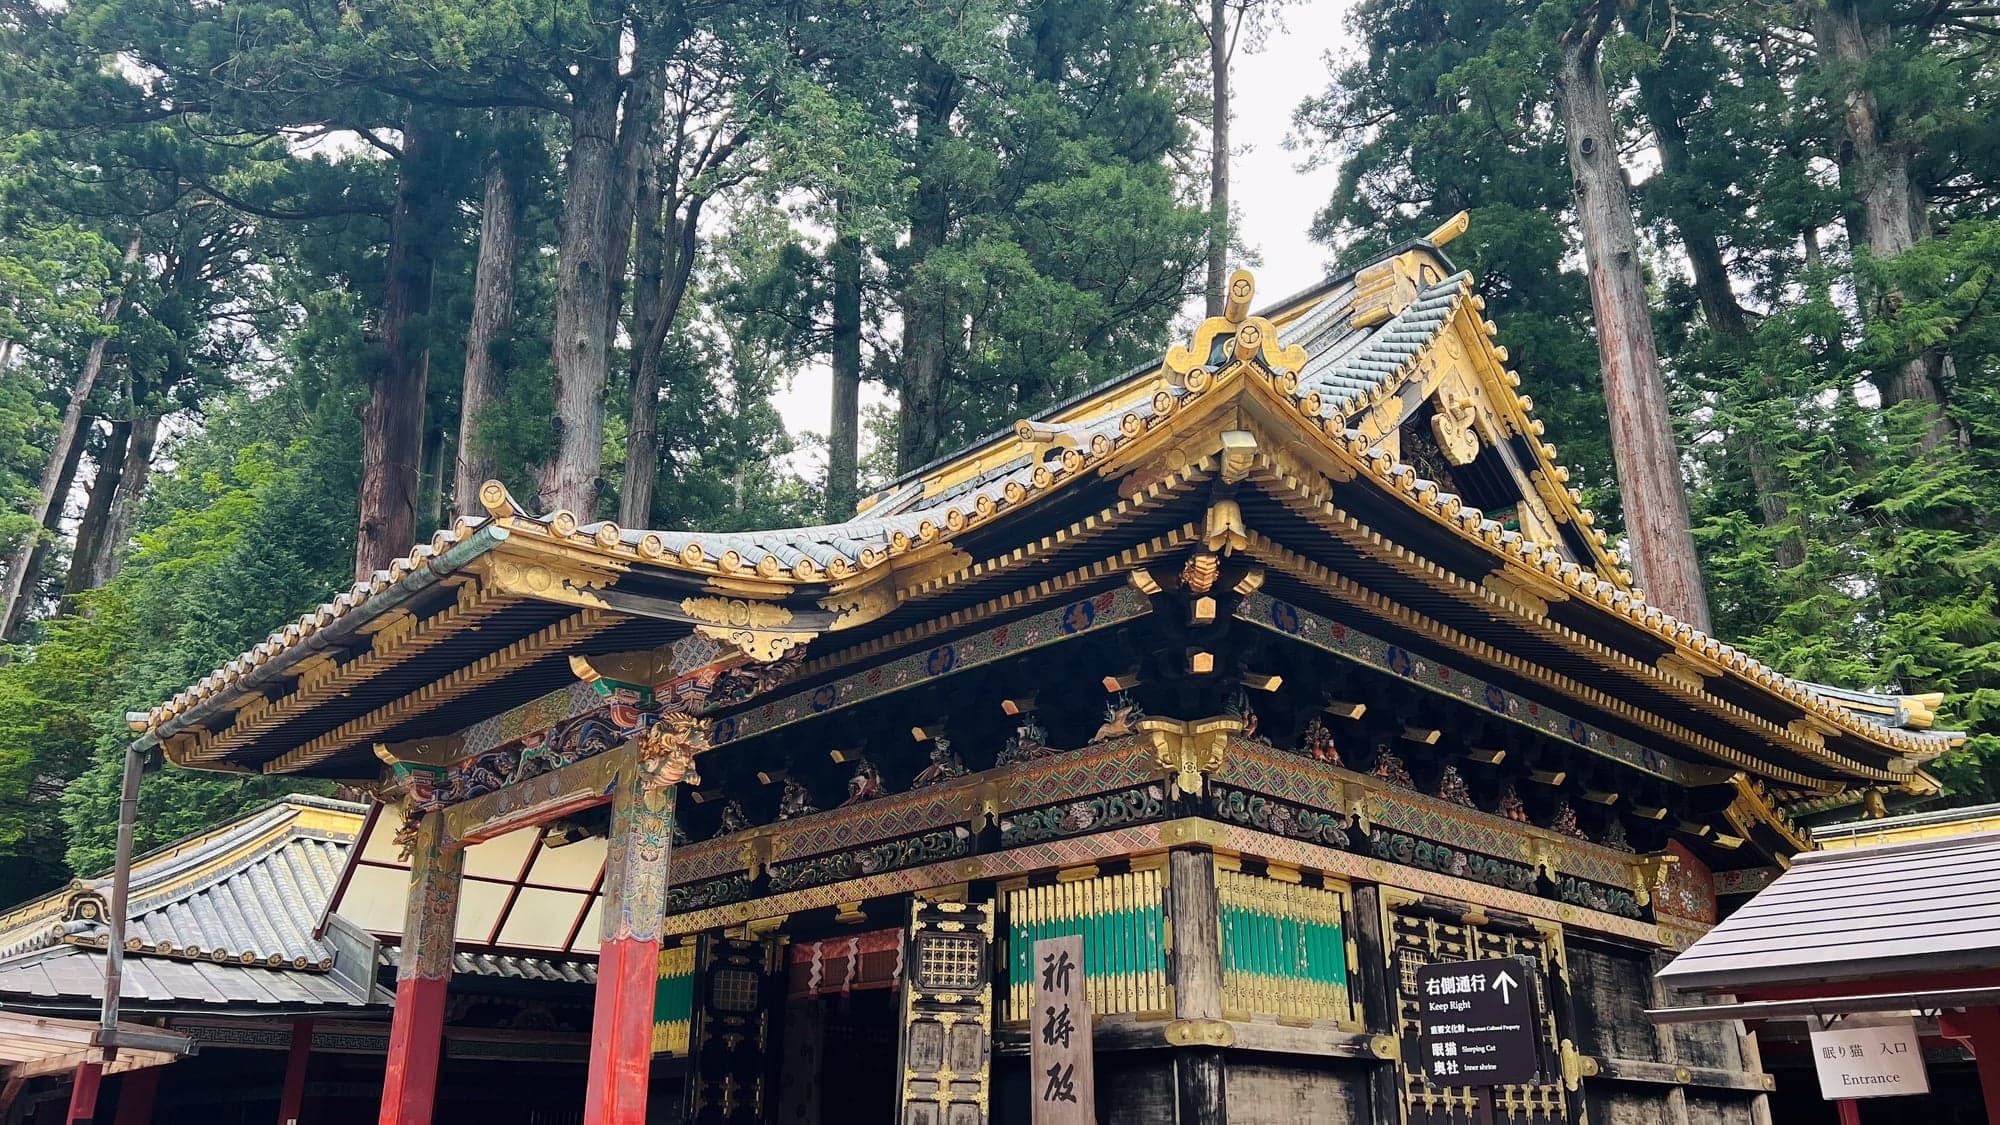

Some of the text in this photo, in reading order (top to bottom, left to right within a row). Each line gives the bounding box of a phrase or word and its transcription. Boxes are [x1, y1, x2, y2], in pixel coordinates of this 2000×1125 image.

[1425, 974, 1486, 996] 右側通行
[1429, 1000, 1471, 1013] Keep Right
[1430, 1024, 1465, 1035] 重要文化財
[1503, 1024, 1520, 1032] Property
[1431, 1041, 1457, 1056] 眠猫
[1461, 1044, 1496, 1054] Sleeping Cat
[1822, 1042, 1907, 1059] 眠り猫 入口
[1434, 1060, 1460, 1075] 奥社
[1464, 1062, 1497, 1071] Inner shrine
[1842, 1073, 1900, 1086] Entrance
